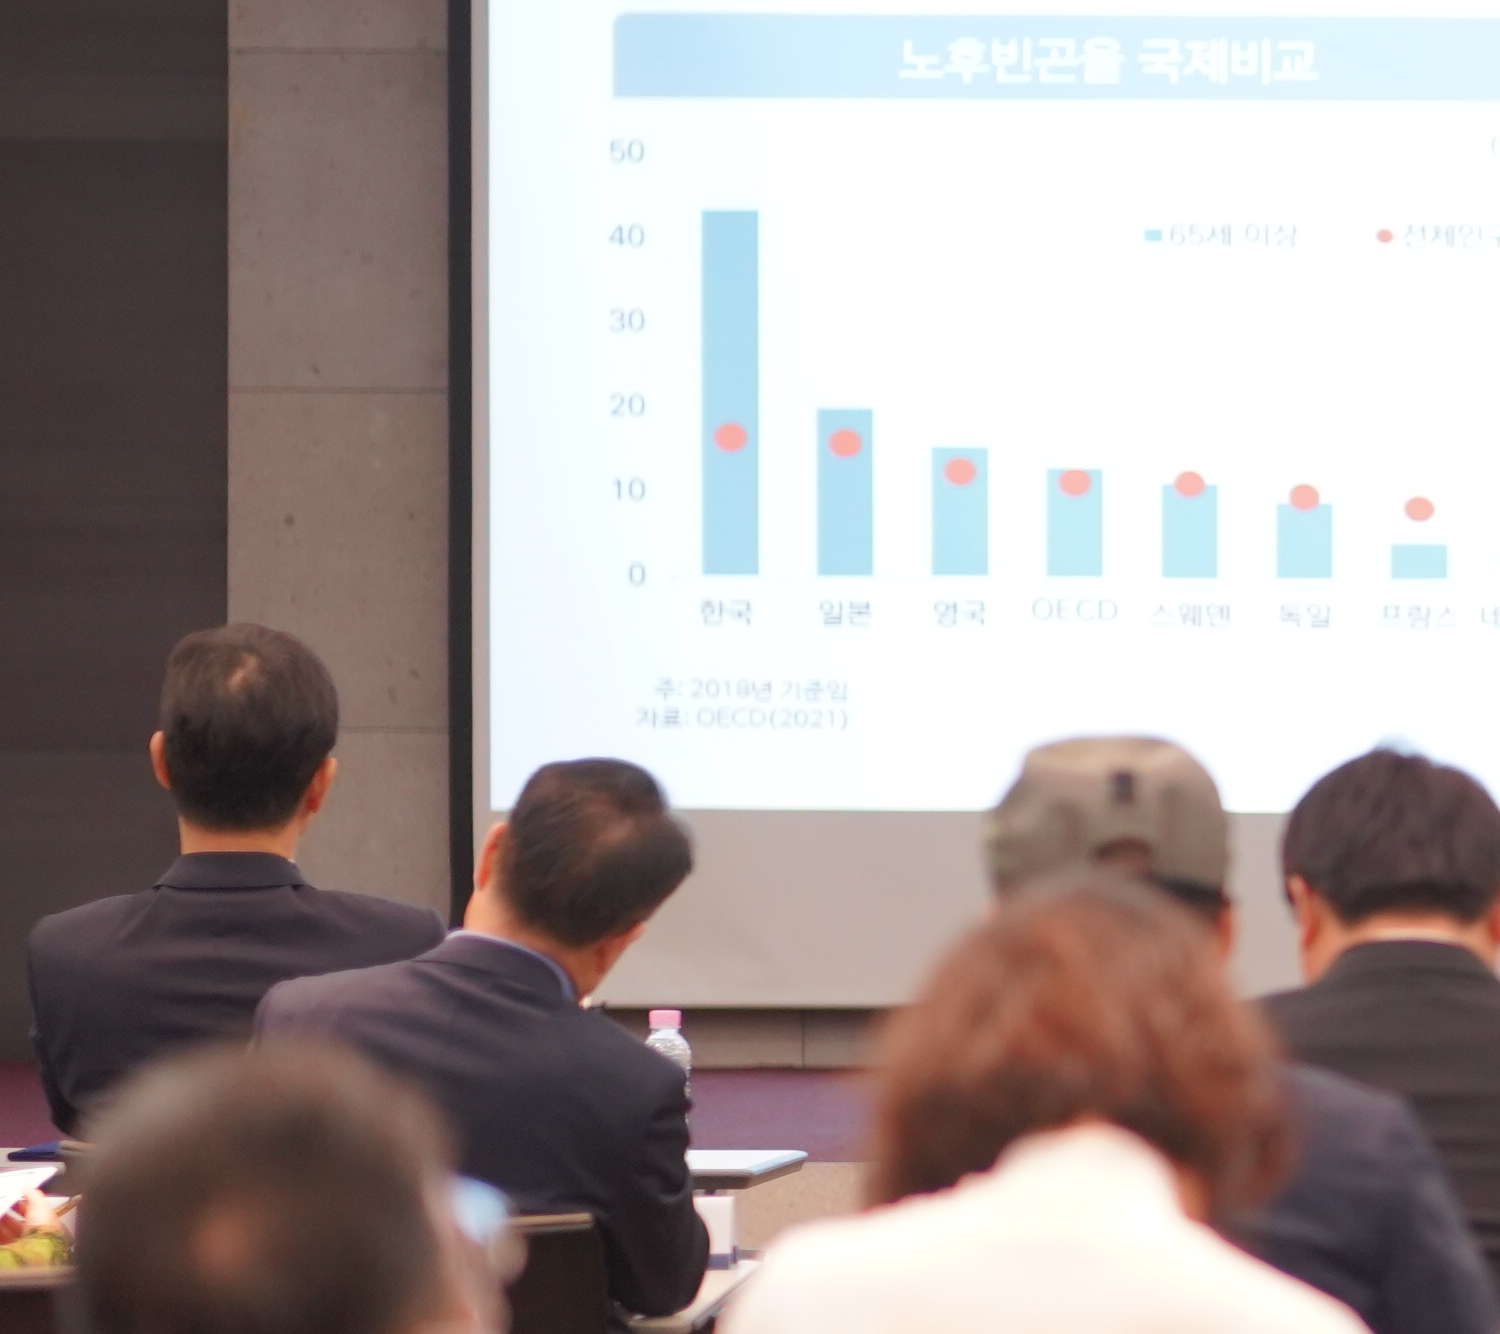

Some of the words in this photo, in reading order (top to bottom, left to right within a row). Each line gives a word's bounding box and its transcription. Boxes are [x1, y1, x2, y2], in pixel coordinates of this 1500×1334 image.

[1138, 39, 1320, 85] 국제비교
[608, 138, 646, 165] 50
[608, 223, 646, 249] 40
[608, 307, 646, 334] 30
[609, 391, 646, 418] 20
[612, 477, 647, 503] 10
[628, 560, 647, 587] 0
[699, 597, 754, 627] 한국
[818, 599, 872, 629] 일본
[932, 599, 987, 629] 영국
[1029, 596, 1120, 622] OECD
[1278, 603, 1332, 630] 독일
[696, 708, 849, 731] OECD(2021)
